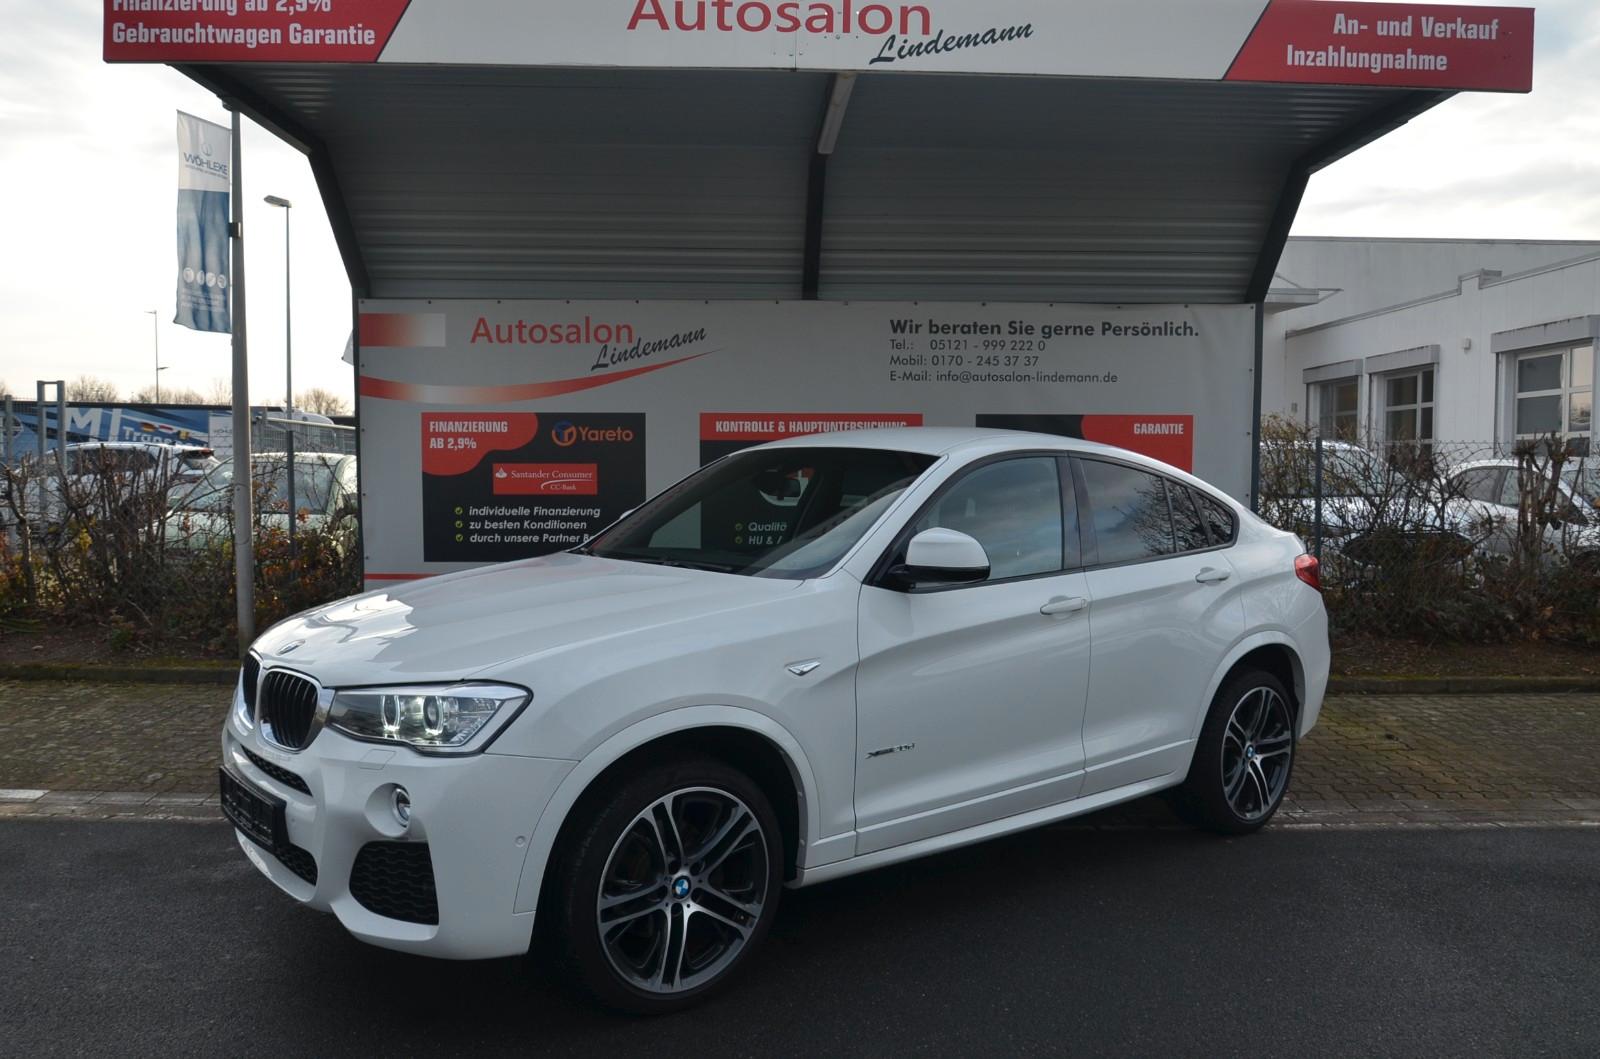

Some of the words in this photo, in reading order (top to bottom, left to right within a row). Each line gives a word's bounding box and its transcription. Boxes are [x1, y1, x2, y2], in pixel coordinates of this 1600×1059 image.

[627, 0, 931, 35] Autosalon
[1333, 13, 1368, 36] An-
[1377, 16, 1412, 37] und
[1421, 16, 1498, 40] Verkauf
[113, 23, 281, 48] Gebrauchtwagen
[289, 24, 375, 46] Garantie
[869, 23, 1034, 65] Lindemann
[1287, 45, 1448, 74] Inzahlungnahme
[470, 316, 633, 345] Autosalon
[889, 319, 923, 335] Wir
[928, 319, 1002, 336] beraten
[1007, 320, 1035, 336] Sie
[1041, 324, 1095, 340] gerne
[1101, 321, 1199, 337] Persönlich.
[591, 326, 707, 372] Lindemann
[889, 339, 914, 351] Tel.:
[930, 339, 968, 351] 05121
[982, 340, 1006, 351] 999
[1010, 340, 1034, 352] 222
[1037, 340, 1046, 352] 0
[889, 355, 927, 367] Mobil:
[931, 355, 963, 367] 0170
[976, 356, 1001, 367] 245
[1004, 356, 1019, 367] 37
[1023, 356, 1039, 367] 37
[889, 370, 932, 382] E-Mail:
[936, 371, 1118, 383] info@autosalon-lindemann.de
[429, 421, 509, 433] FINANZIERUNG
[715, 420, 775, 433] KONTROLLE
[778, 421, 786, 433] &
[1133, 423, 1184, 435] GARANTIE
[579, 426, 634, 442] Yareto
[429, 437, 444, 449] AB
[447, 437, 477, 451] 2,9%
[511, 469, 550, 479] Santander
[551, 470, 593, 479] Consumer
[469, 506, 531, 517] individuelle
[533, 506, 601, 518] Finanzierung
[469, 521, 481, 530] zu
[484, 520, 520, 530] besten
[523, 520, 587, 530] Konditionen
[470, 533, 501, 543] durch
[504, 535, 539, 543] unsere
[542, 533, 580, 543] Partner
